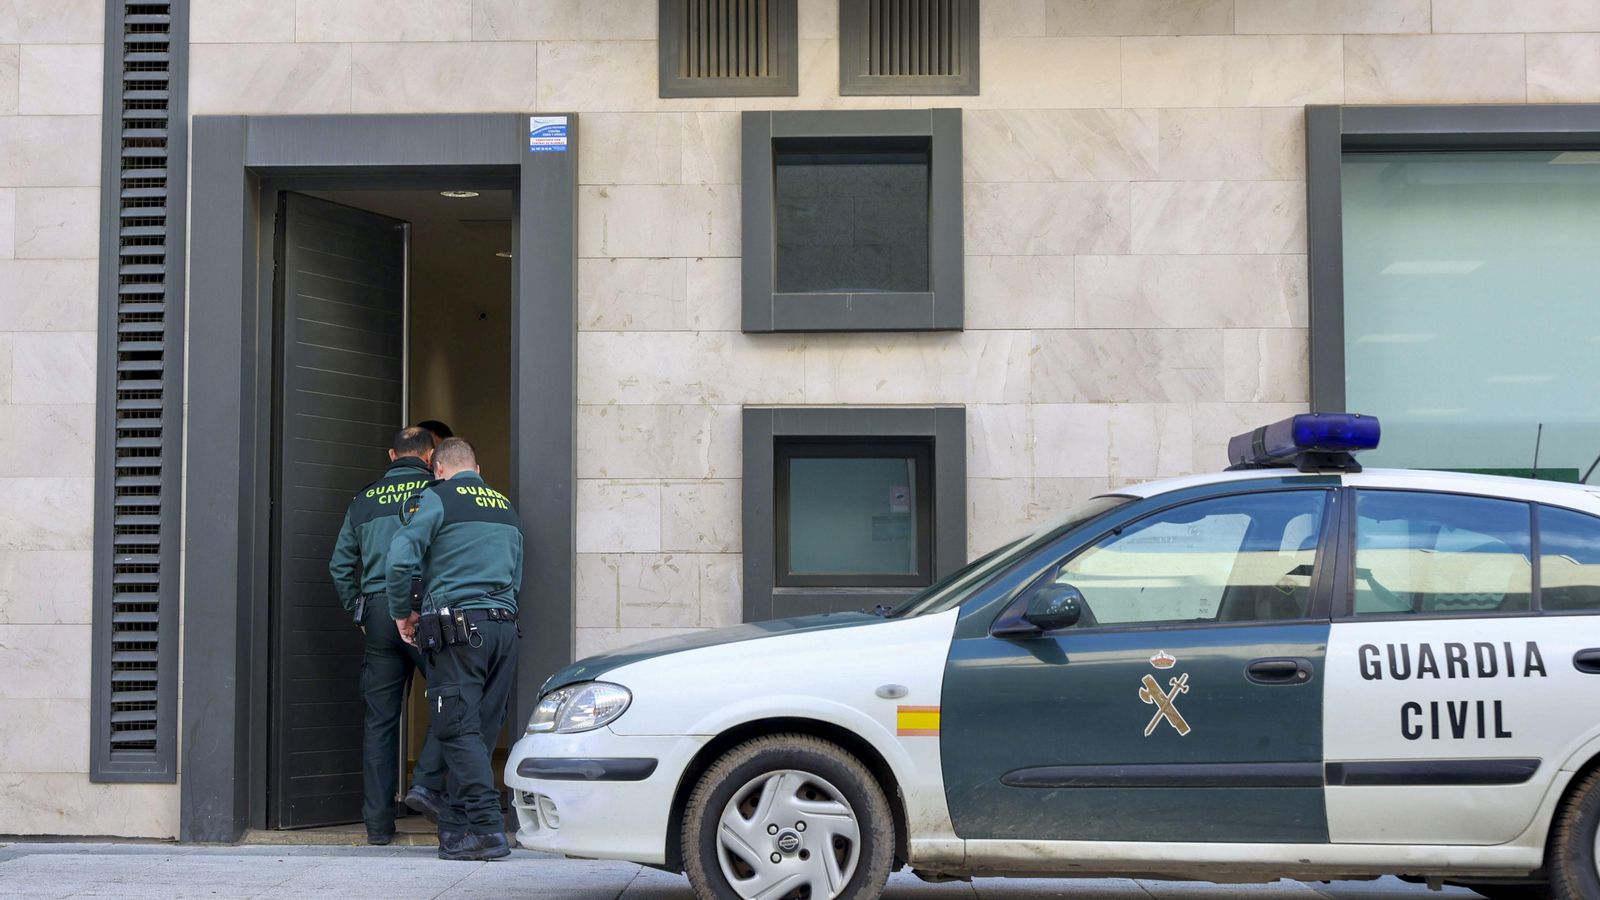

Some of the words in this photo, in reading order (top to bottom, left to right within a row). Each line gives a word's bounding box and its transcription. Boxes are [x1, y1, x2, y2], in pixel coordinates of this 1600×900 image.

[456, 486, 511, 504] GUARDI
[475, 496, 509, 511] CIVIL
[1358, 641, 1548, 681] GUARDIA
[1400, 700, 1513, 741] CIVIL
